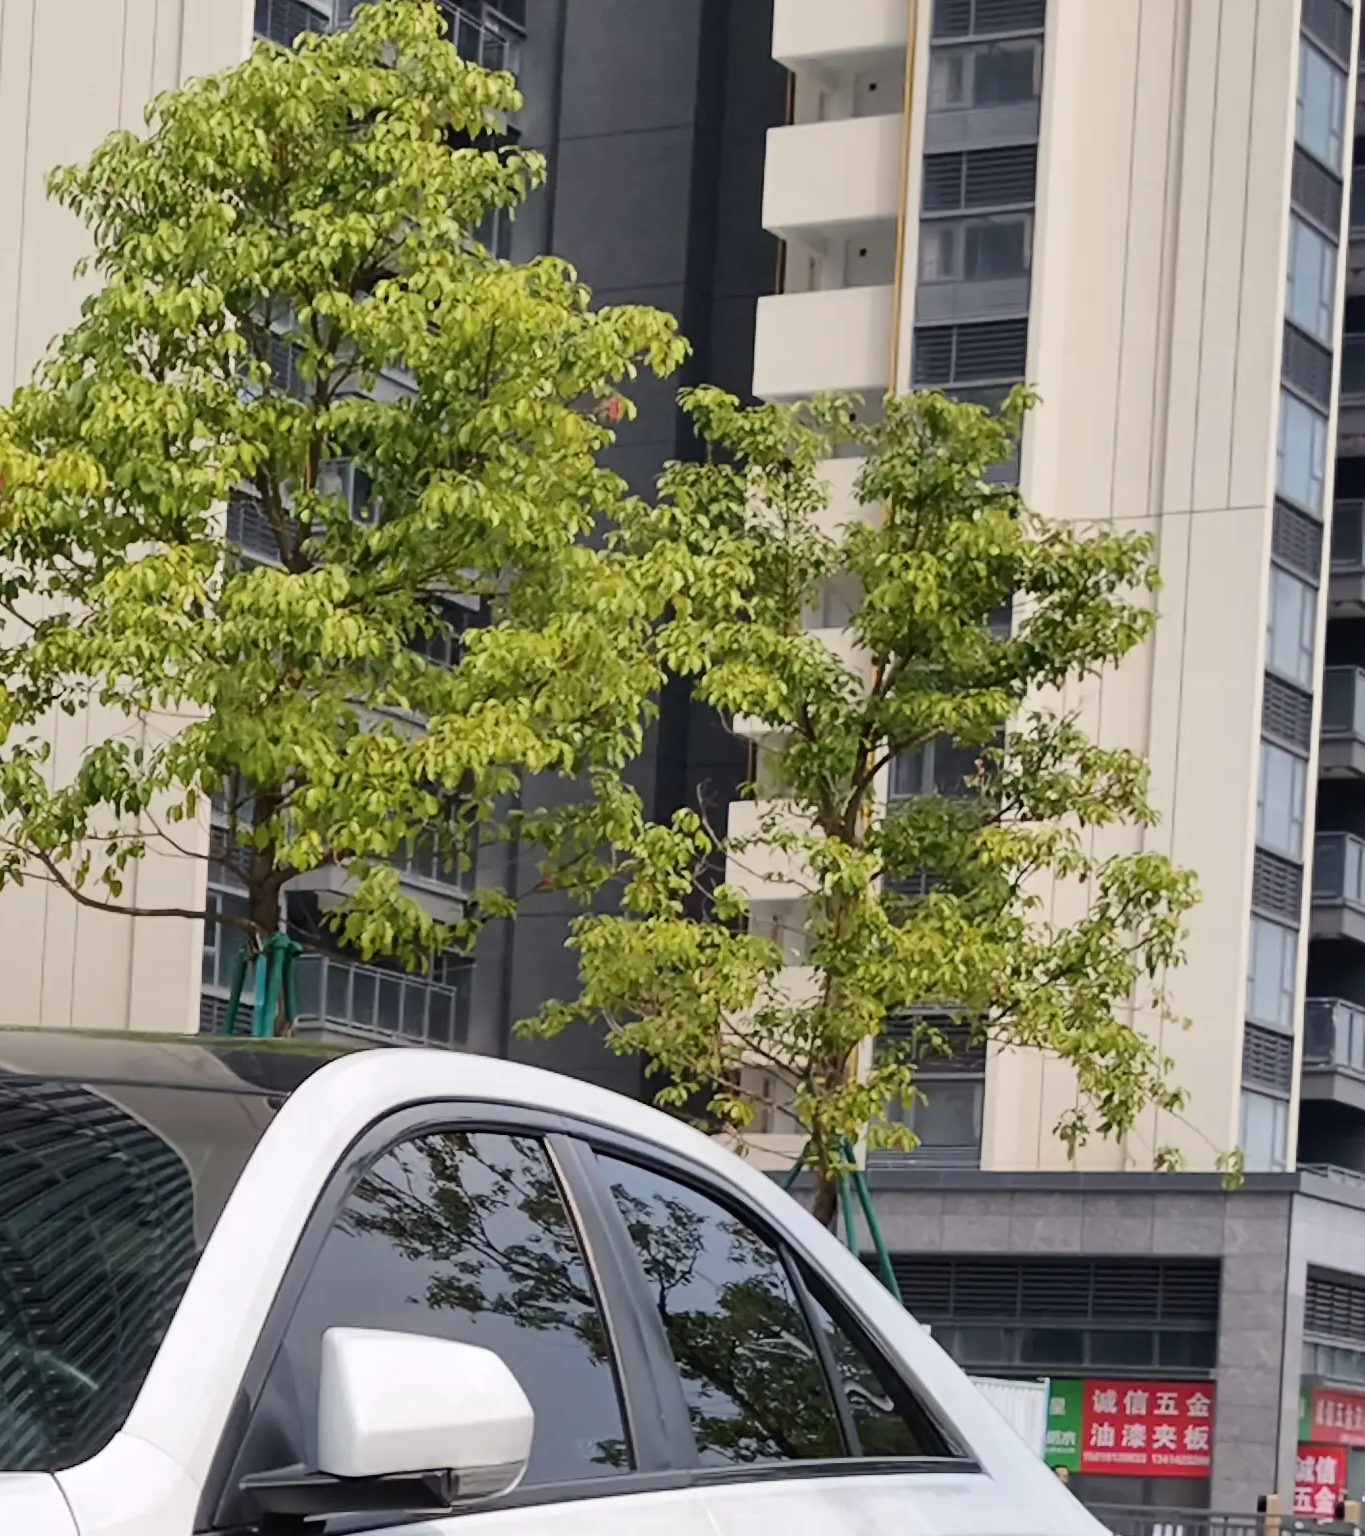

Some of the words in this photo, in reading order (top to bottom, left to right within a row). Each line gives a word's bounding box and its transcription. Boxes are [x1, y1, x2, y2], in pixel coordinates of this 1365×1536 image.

[1092, 1389, 1212, 1418] 诚信五金
[1089, 1422, 1210, 1450] 油漆夹板
[1292, 1455, 1337, 1485] 诚信
[1292, 1485, 1336, 1514] 五金
